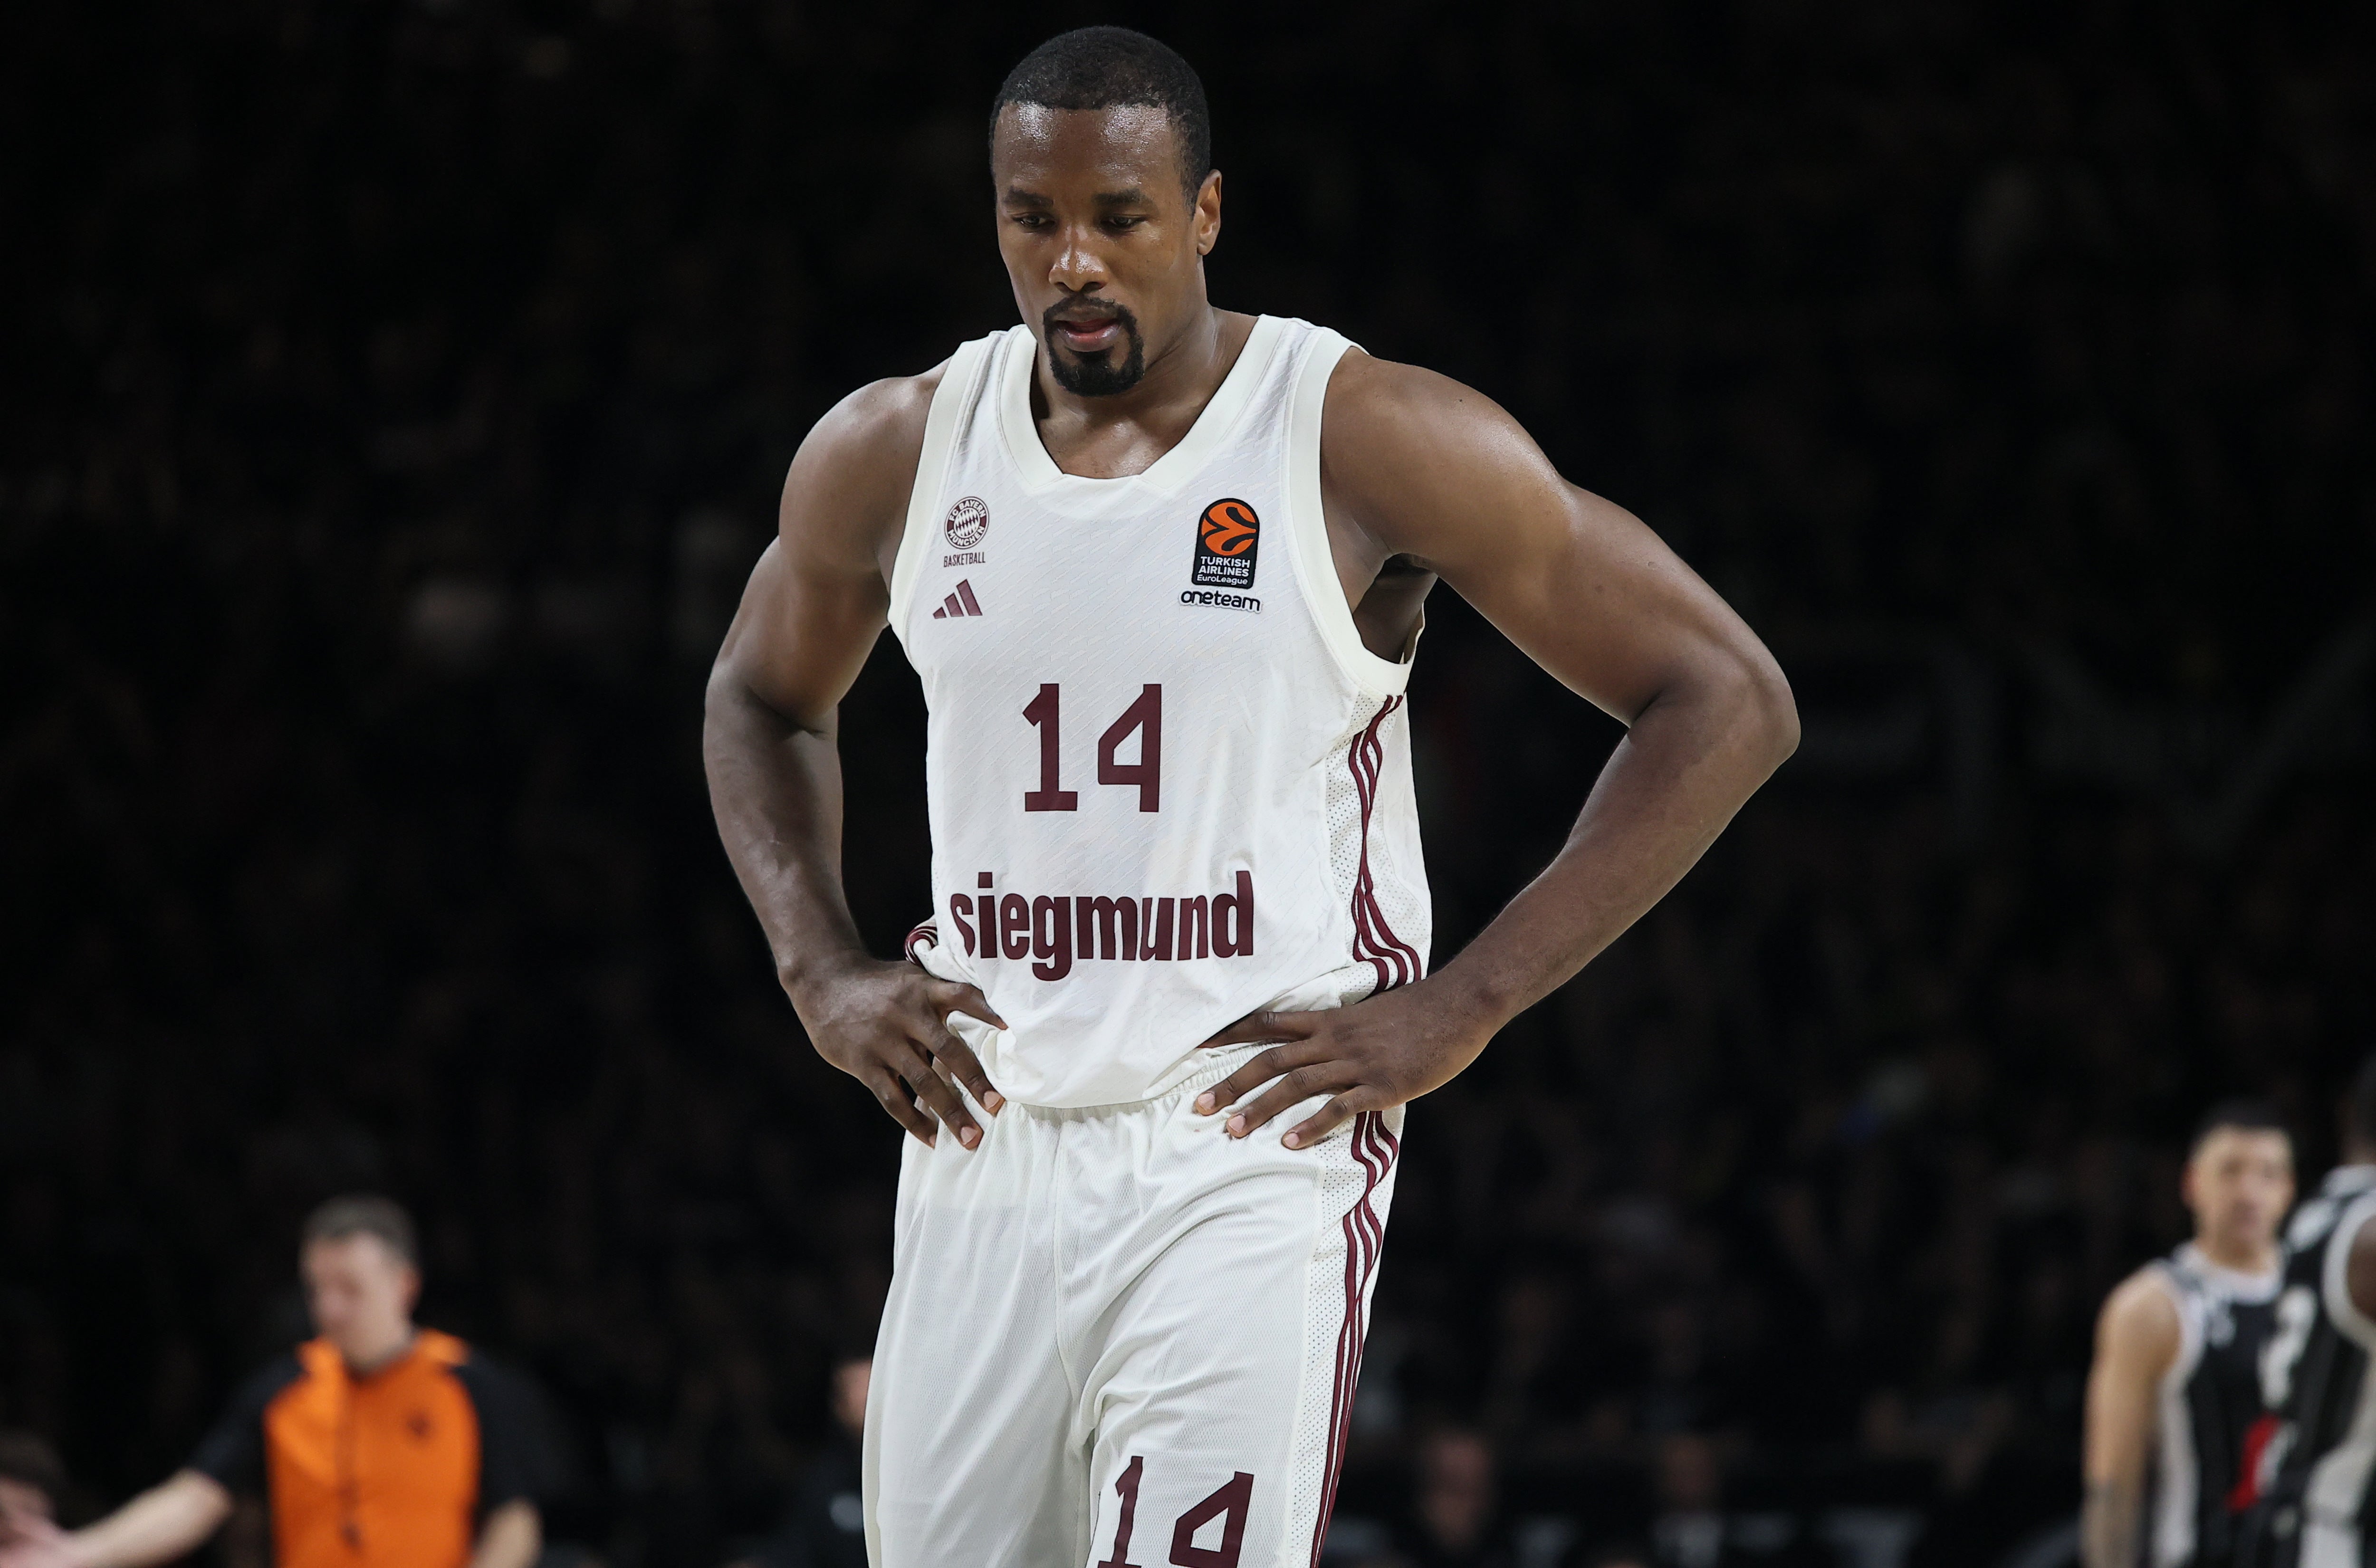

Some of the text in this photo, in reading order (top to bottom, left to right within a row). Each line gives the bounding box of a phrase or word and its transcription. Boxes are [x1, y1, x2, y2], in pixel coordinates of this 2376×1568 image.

[949, 500, 986, 521] FC BAYERN
[943, 552, 986, 567] BASKETBALL
[1200, 556, 1251, 568] TURKISH
[1197, 574, 1248, 585] EuroLeague
[1198, 565, 1249, 577] AIRLINES
[1181, 590, 1261, 612] oneteam
[1022, 683, 1162, 813] 14
[949, 870, 1254, 982] siegmund
[1097, 1455, 1255, 1568] 14
